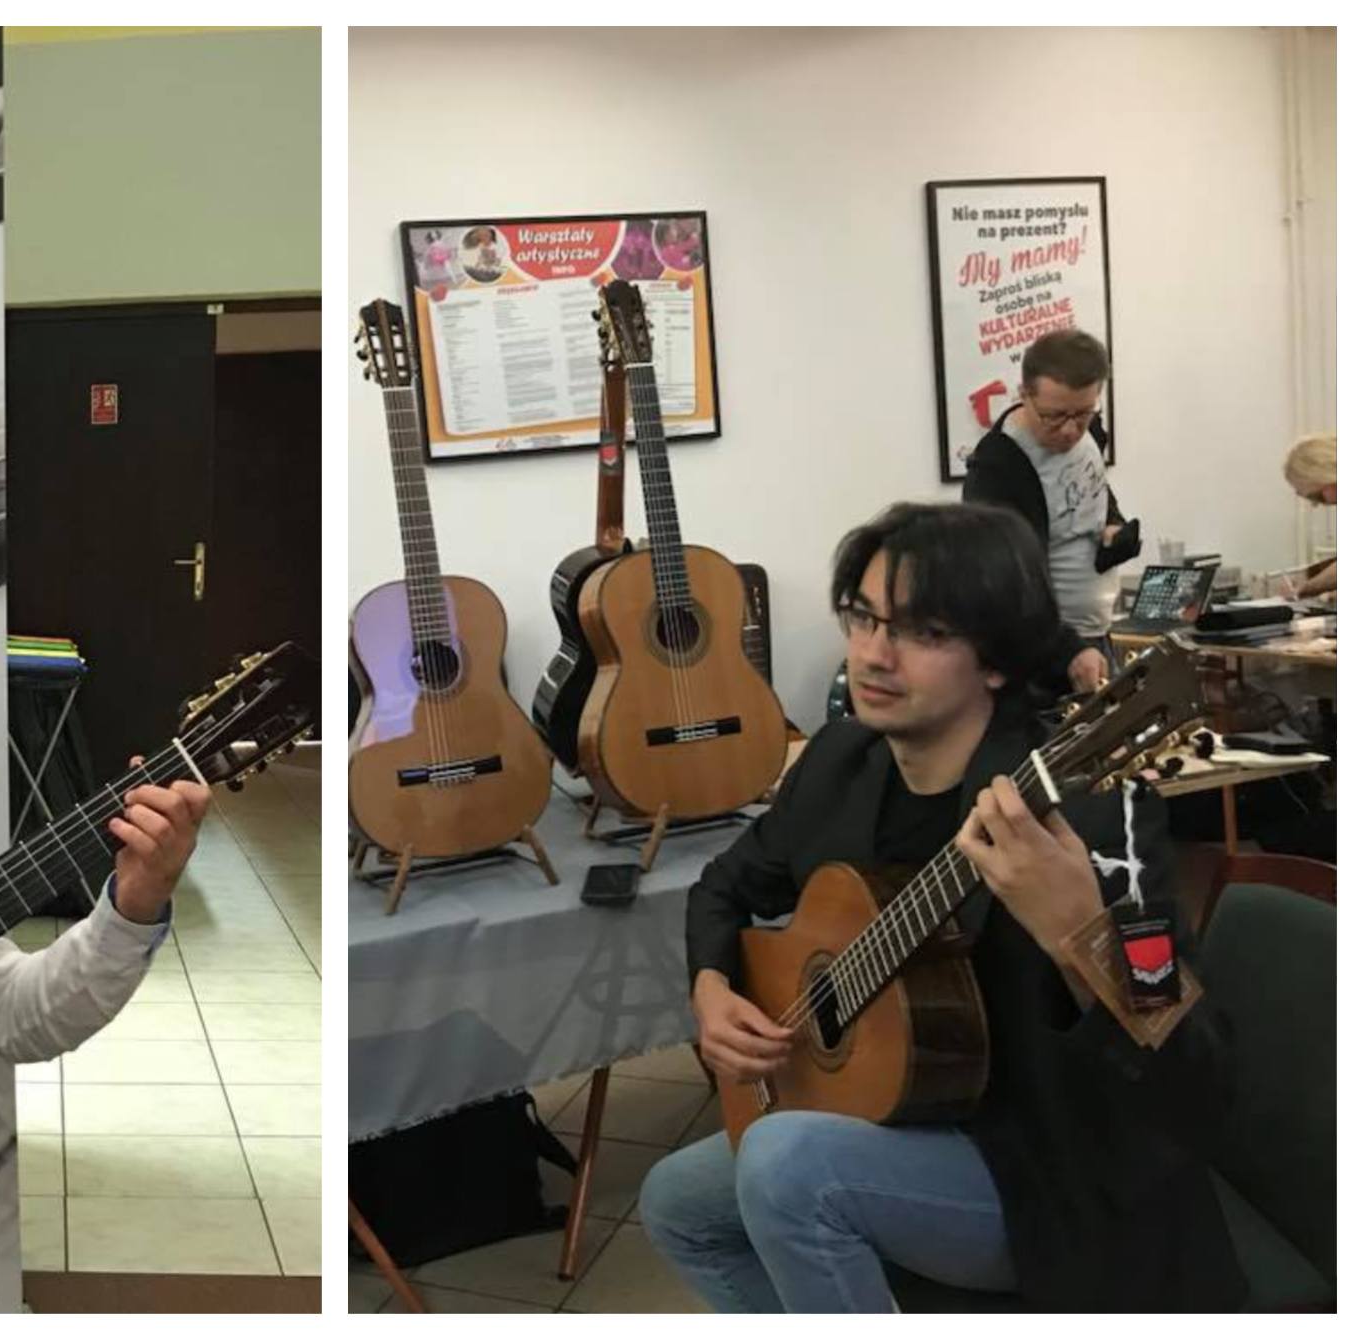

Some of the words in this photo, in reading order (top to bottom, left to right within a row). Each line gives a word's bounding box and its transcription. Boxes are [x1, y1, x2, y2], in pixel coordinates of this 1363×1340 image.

[952, 205, 979, 221] Nie
[982, 208, 1021, 220] masz
[978, 227, 996, 238] na
[1000, 222, 1066, 241] prezent?
[959, 251, 1000, 288] My
[1011, 224, 1087, 273] mamy!
[1037, 291, 1052, 303] na
[979, 296, 1073, 338] KULTURALNE
